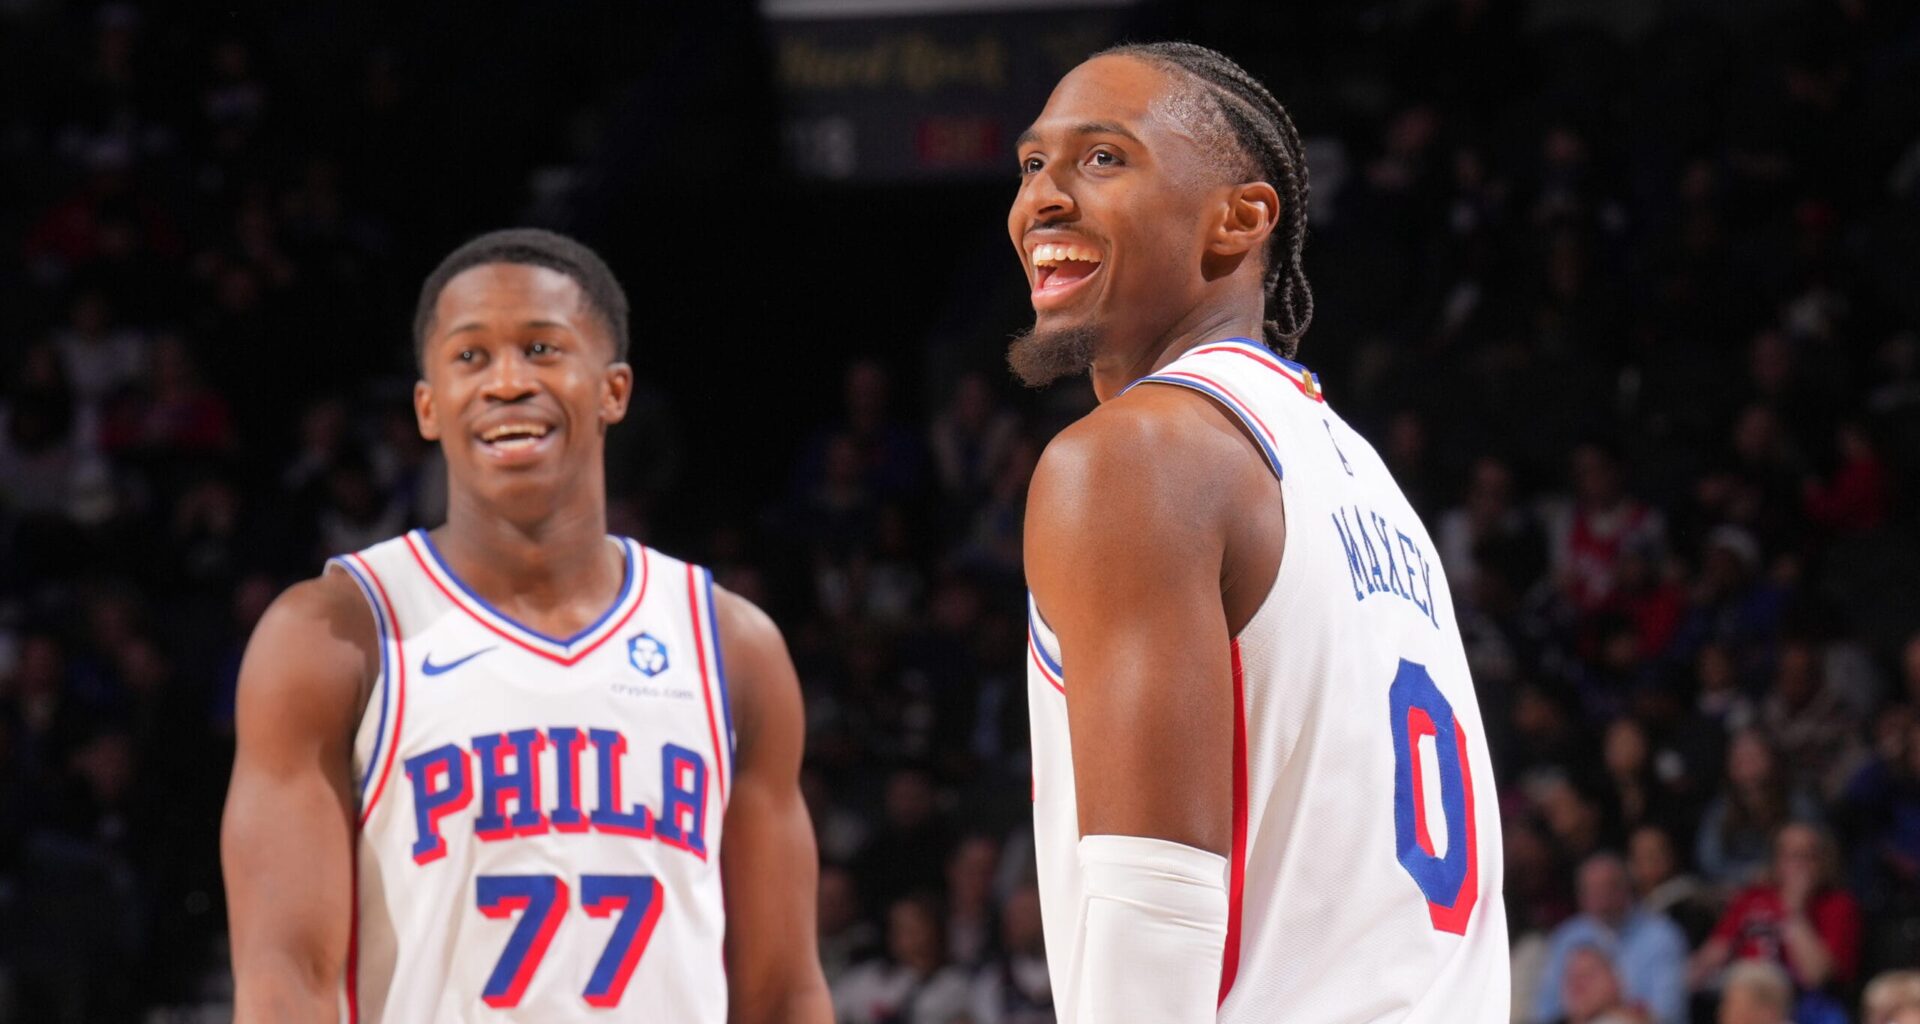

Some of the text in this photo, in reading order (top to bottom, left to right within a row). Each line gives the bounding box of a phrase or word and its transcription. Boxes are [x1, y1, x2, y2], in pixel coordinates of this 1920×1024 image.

[1331, 504, 1440, 630] MAXEY
[403, 727, 709, 866] PHILA
[1389, 656, 1479, 937] 0
[475, 875, 664, 1009] 77
